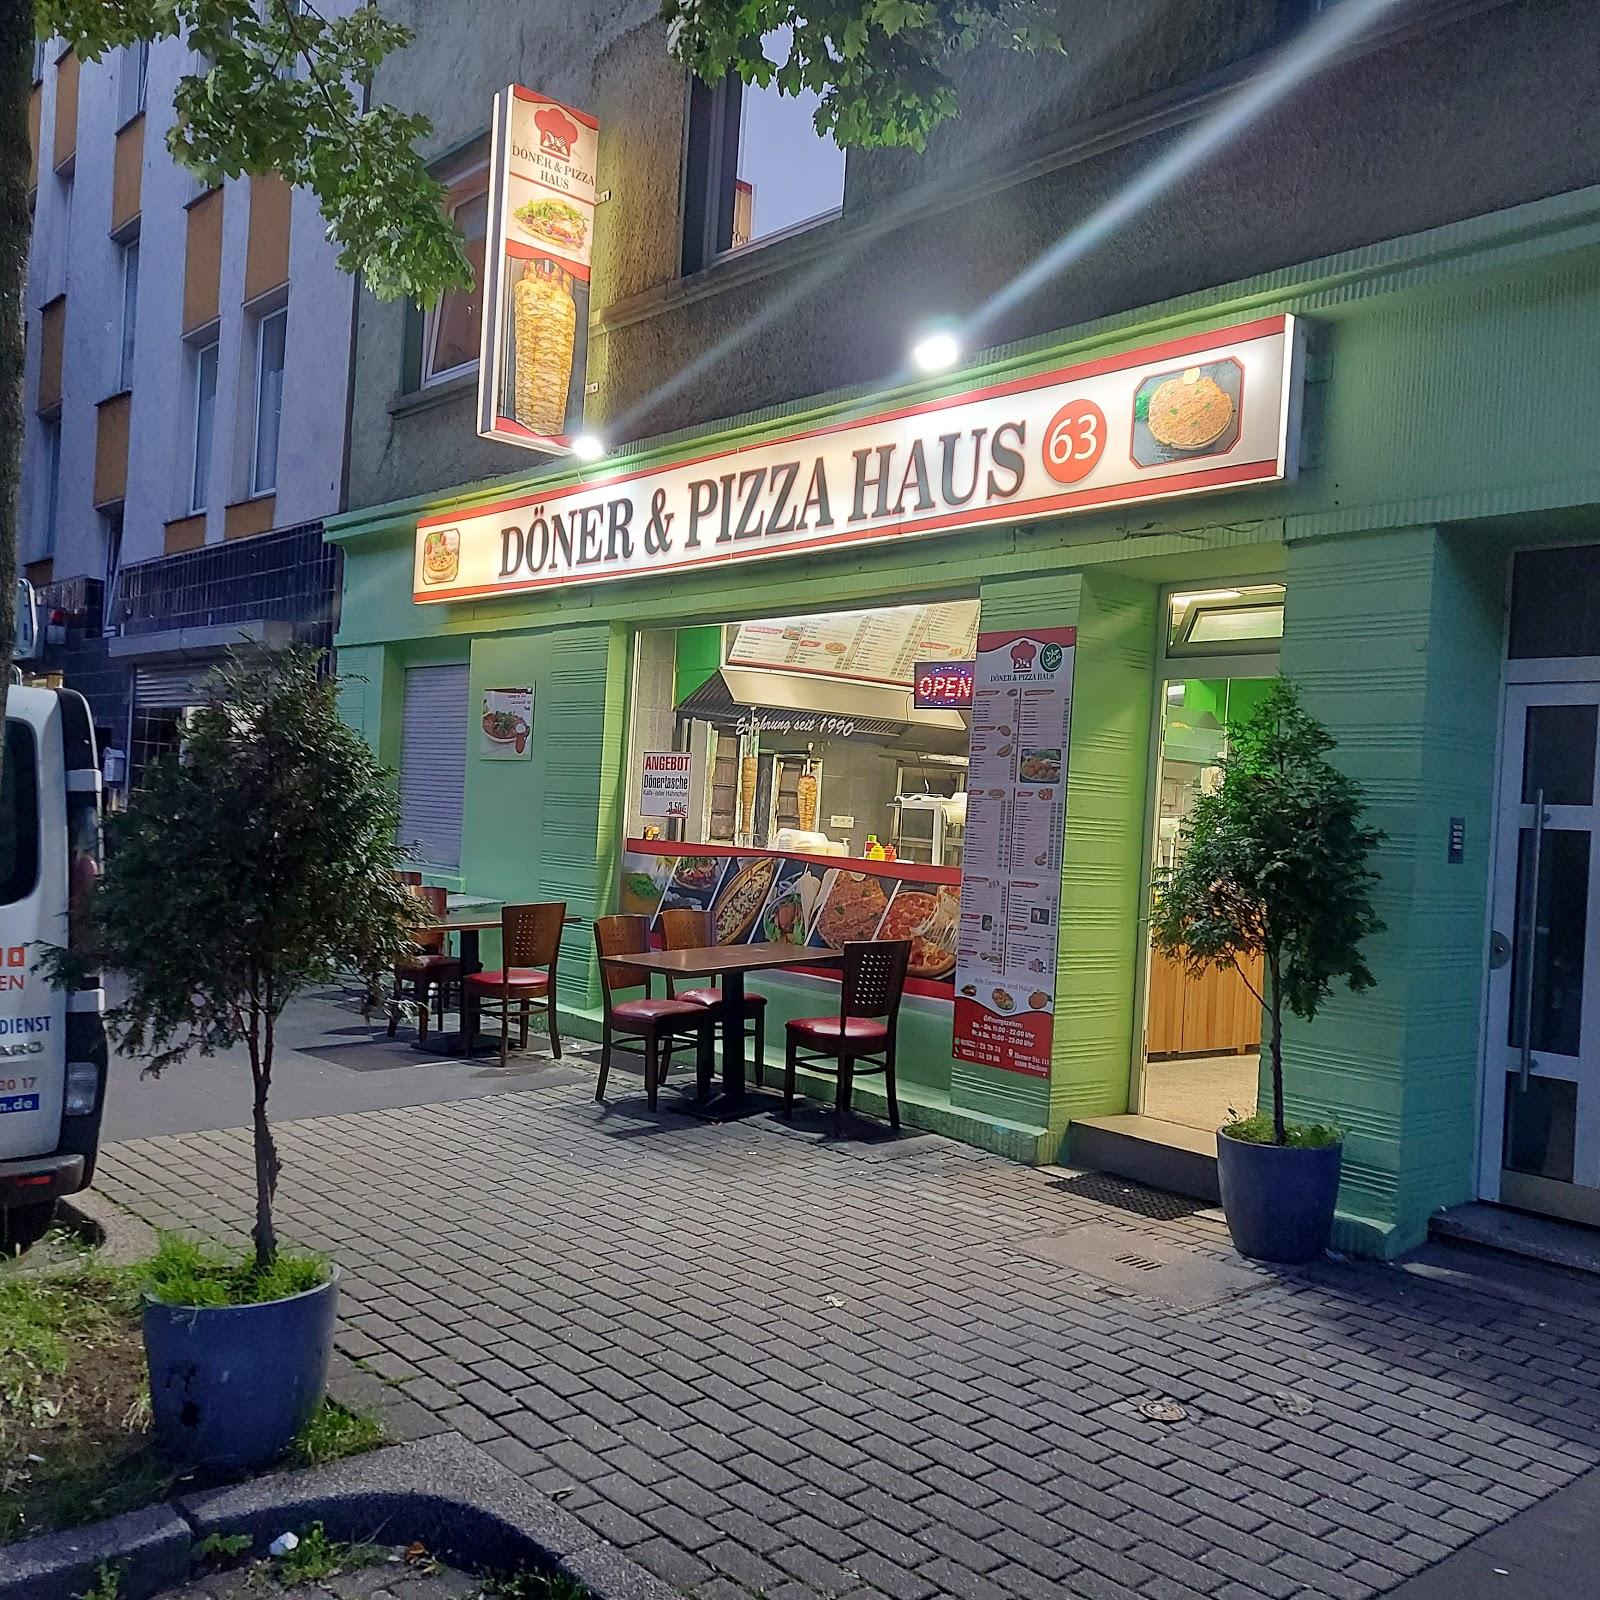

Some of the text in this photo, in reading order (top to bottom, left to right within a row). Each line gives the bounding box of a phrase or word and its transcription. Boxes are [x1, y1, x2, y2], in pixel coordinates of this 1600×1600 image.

[512, 145, 595, 187] DÖNER & PIZZA
[540, 170, 569, 189] HAUS
[1049, 413, 1098, 465] 63
[499, 420, 1026, 577] DÖNER & PIZZA HAUS
[919, 677, 973, 697] OPEN
[793, 719, 816, 731] seit
[819, 717, 854, 737] 1990
[645, 756, 690, 771] ANGEBOT
[643, 774, 688, 790] Dönertasche
[0, 1016, 51, 1034] DIENST
